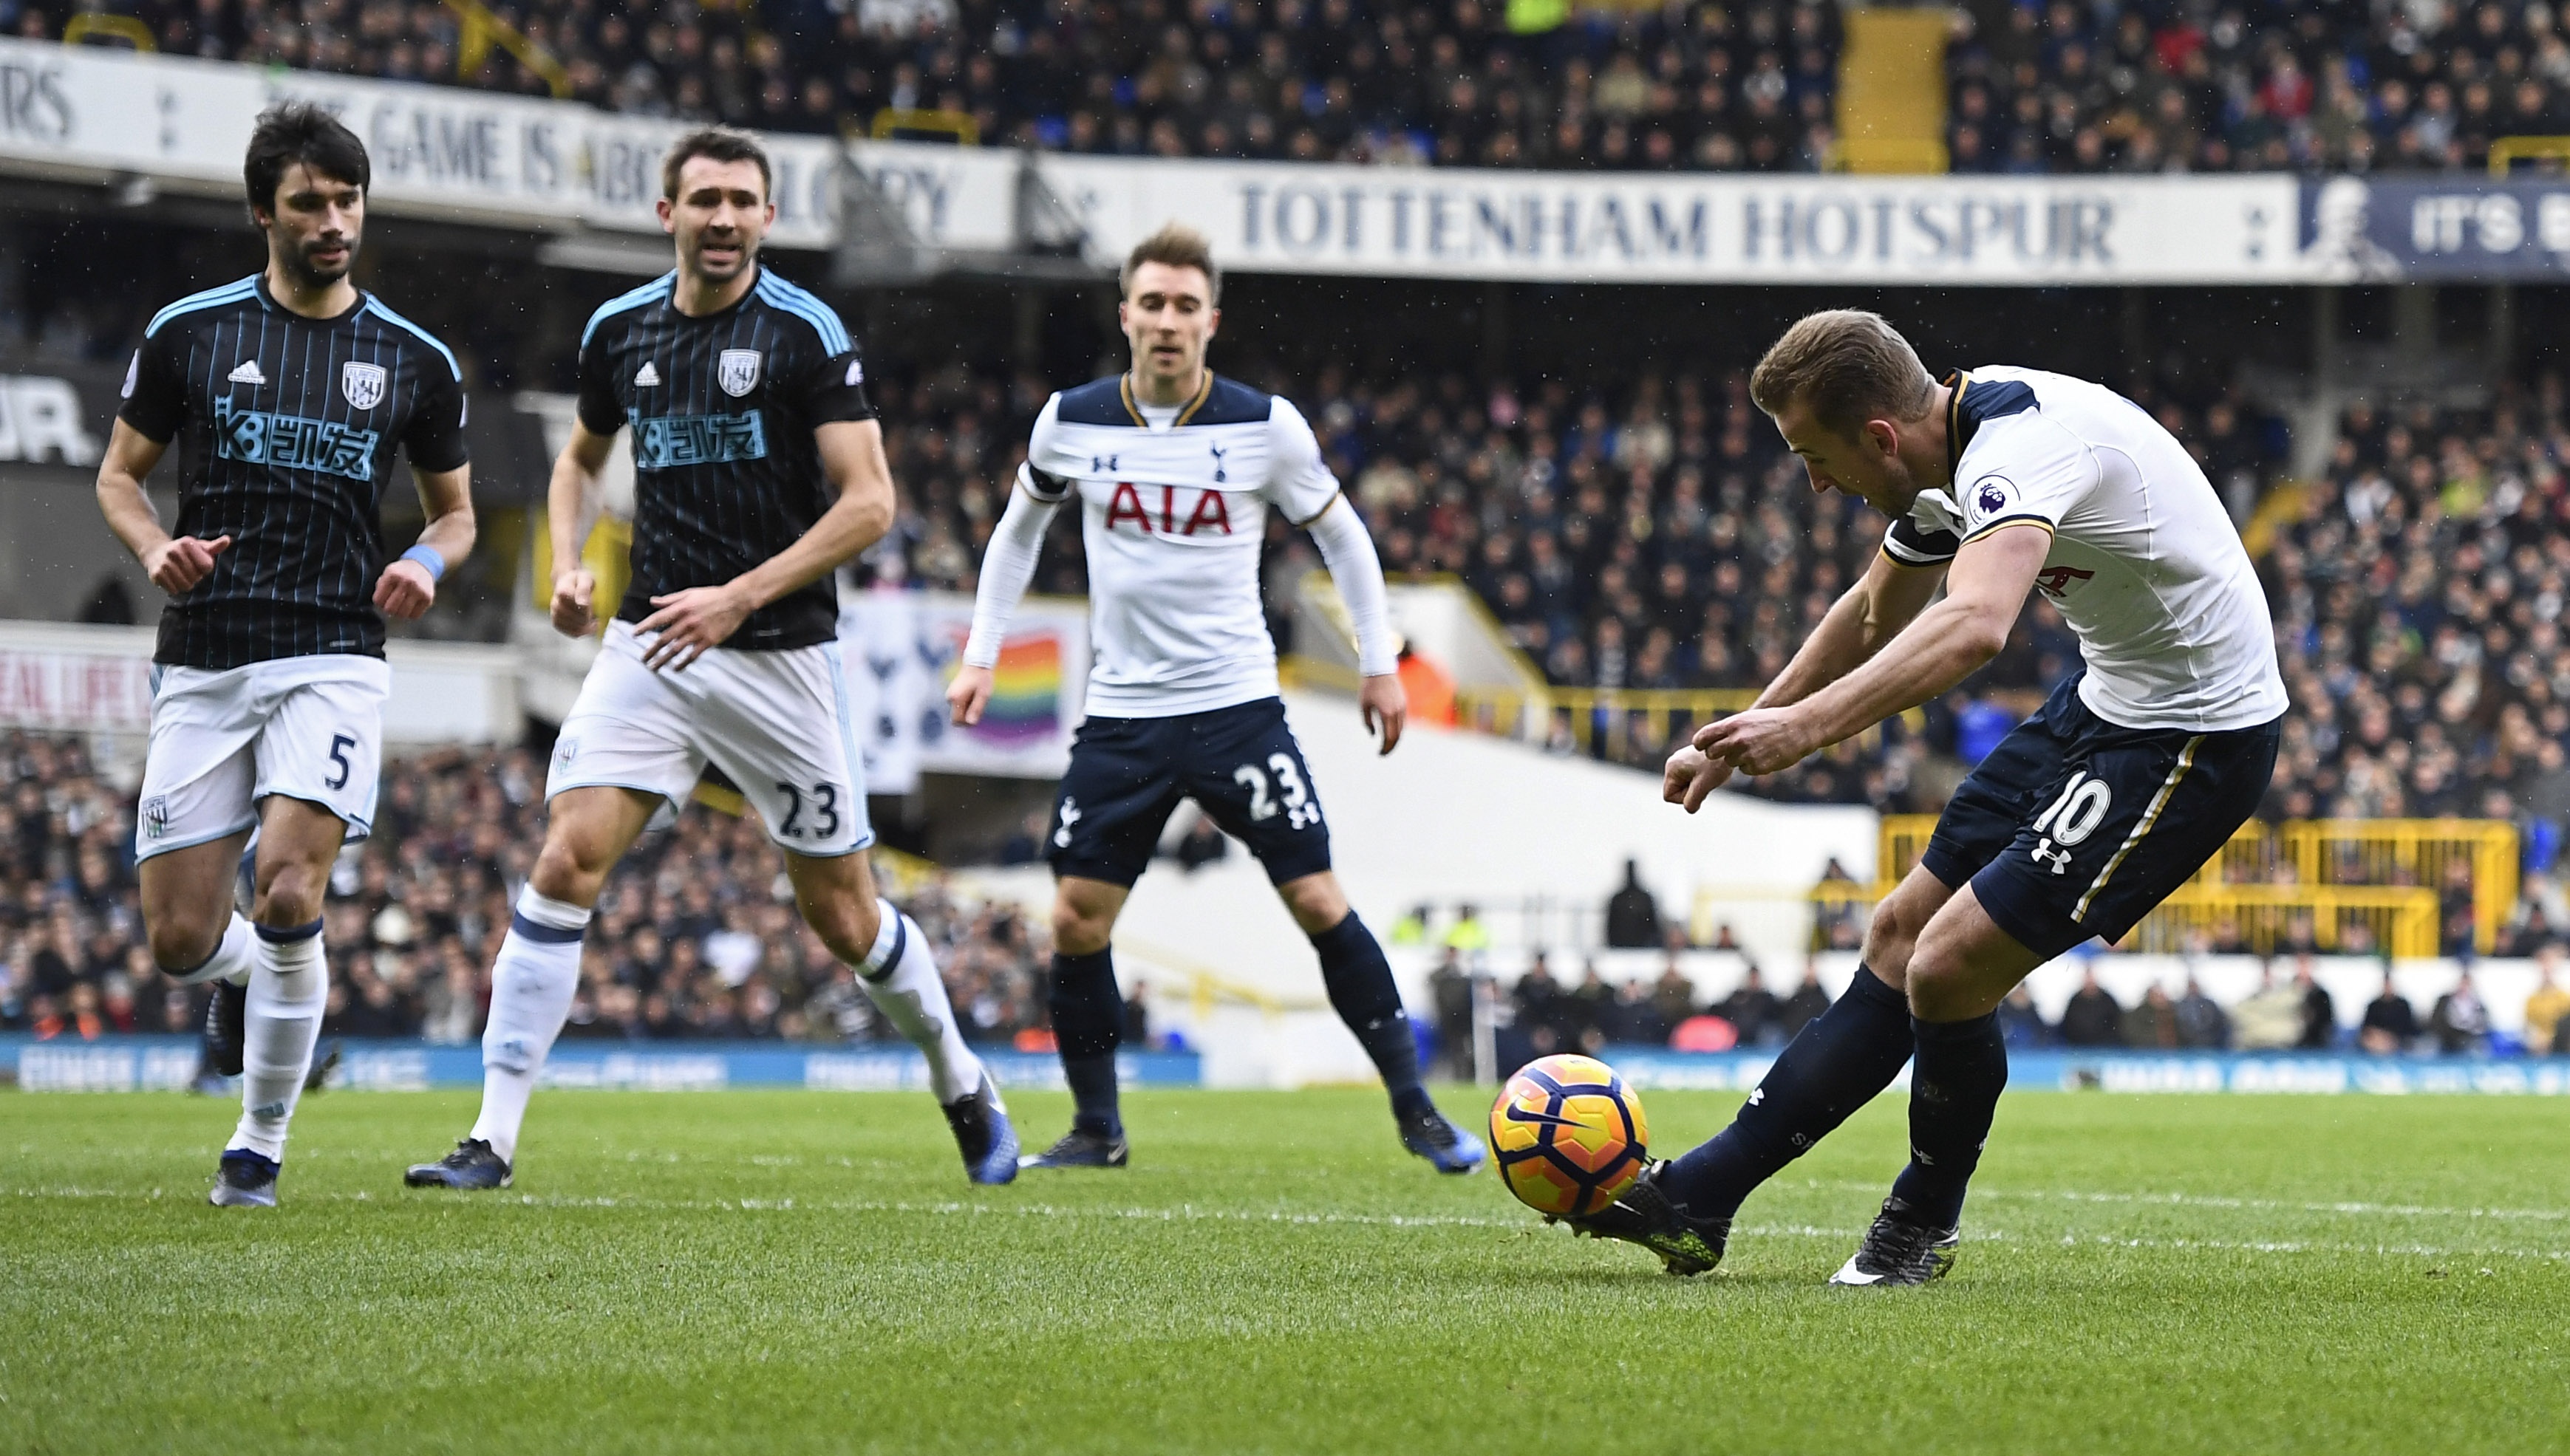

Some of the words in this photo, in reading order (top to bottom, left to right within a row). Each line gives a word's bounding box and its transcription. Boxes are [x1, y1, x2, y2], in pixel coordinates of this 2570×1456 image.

[369, 99, 502, 186] GAME
[523, 120, 560, 189] IS
[1238, 179, 1709, 259] TOTTENHAM
[1744, 192, 2116, 264] HOTSPUR
[2411, 194, 2525, 253] IT'S
[1105, 482, 1233, 536] AIA
[322, 731, 358, 792] 5
[1233, 751, 1308, 822] 23
[776, 782, 839, 840] 23
[2032, 770, 2112, 847] 10
